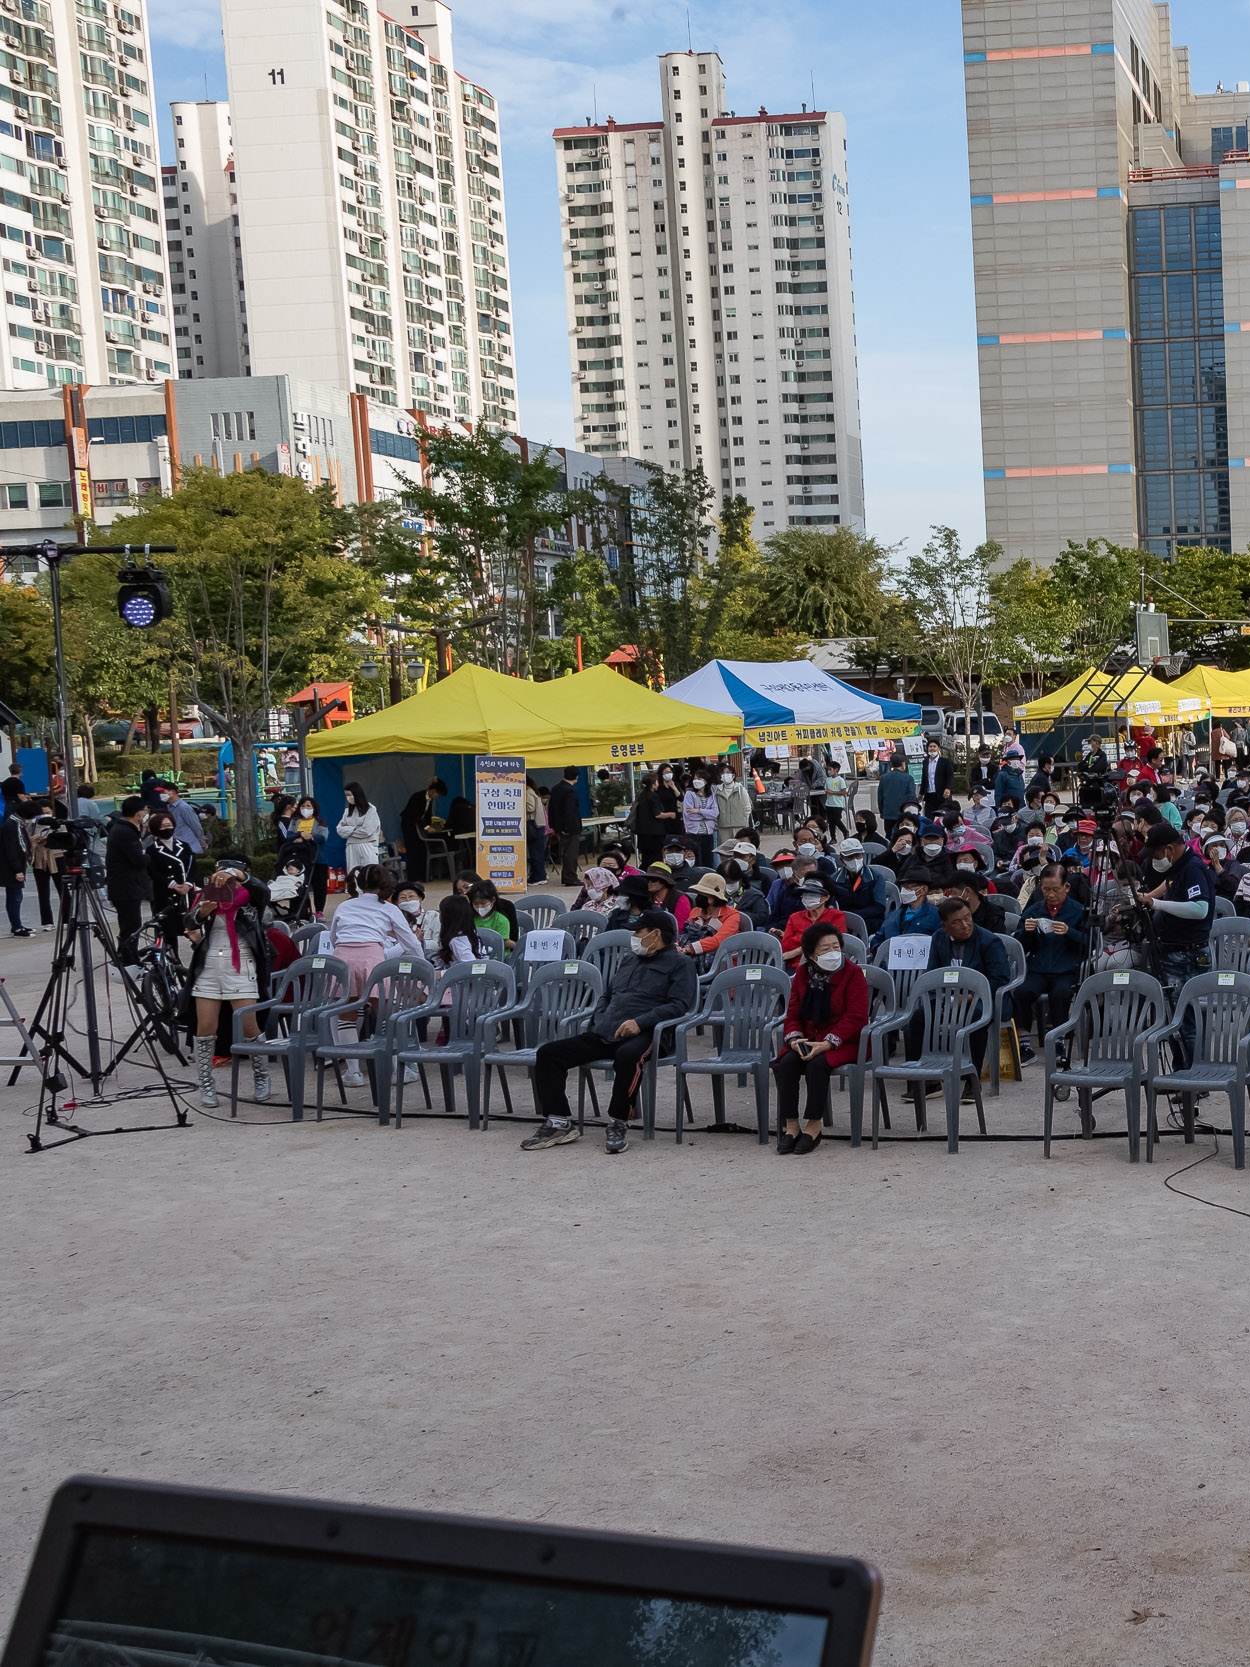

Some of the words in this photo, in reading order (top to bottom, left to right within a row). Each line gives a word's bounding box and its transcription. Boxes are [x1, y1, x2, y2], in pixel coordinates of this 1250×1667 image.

[268, 68, 285, 85] 11
[80, 472, 89, 502] 노래방
[758, 730, 788, 742] 냅킨아트
[795, 728, 828, 740] 커피클레이
[611, 744, 645, 757] 운영본부
[503, 788, 522, 797] 축제
[487, 801, 516, 810] 한마당
